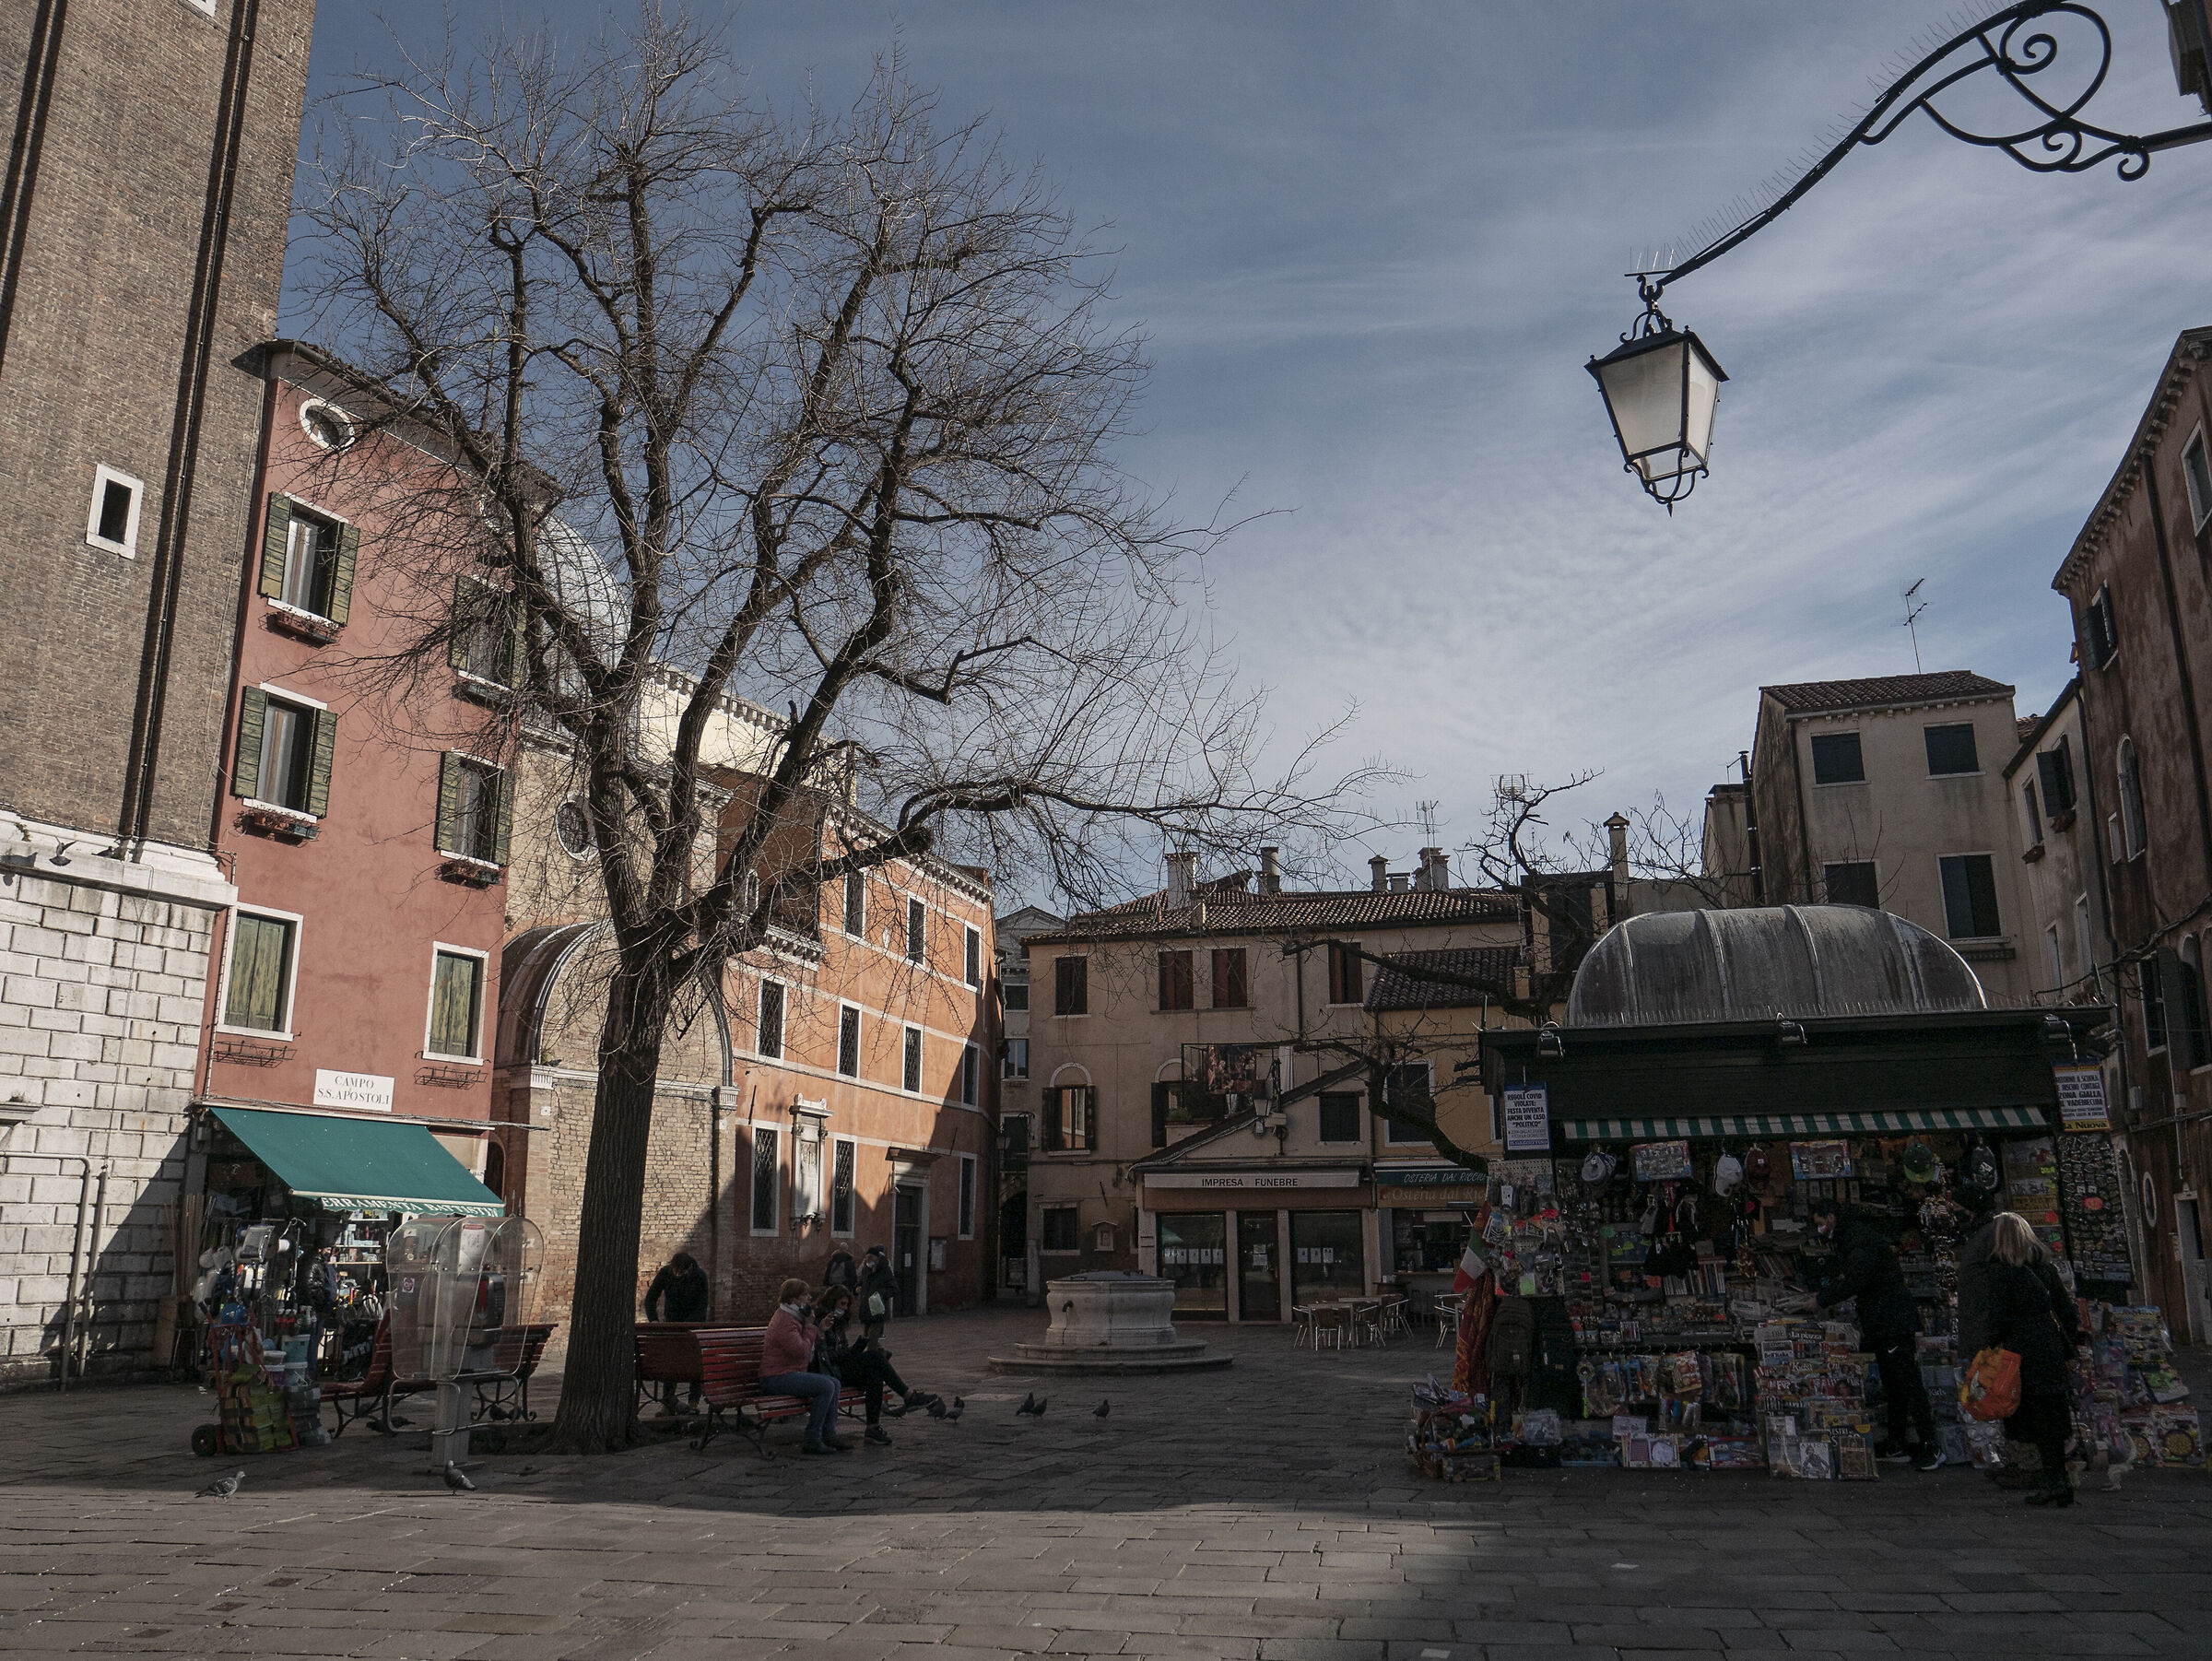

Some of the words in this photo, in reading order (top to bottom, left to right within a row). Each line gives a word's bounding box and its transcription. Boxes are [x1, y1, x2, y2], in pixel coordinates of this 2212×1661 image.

[335, 1076, 374, 1089] CAMPO
[317, 1088, 335, 1099] S.S.
[335, 1090, 389, 1104] APOSTOLI
[2075, 1121, 2107, 1129] Nuova
[1202, 1178, 1243, 1186] IMPRESA
[1254, 1178, 1299, 1186] FUNEBRE
[1404, 1172, 1438, 1183] OSTERIA
[1441, 1172, 1456, 1183] DAL
[321, 1197, 423, 1212] ERRAMENTA
